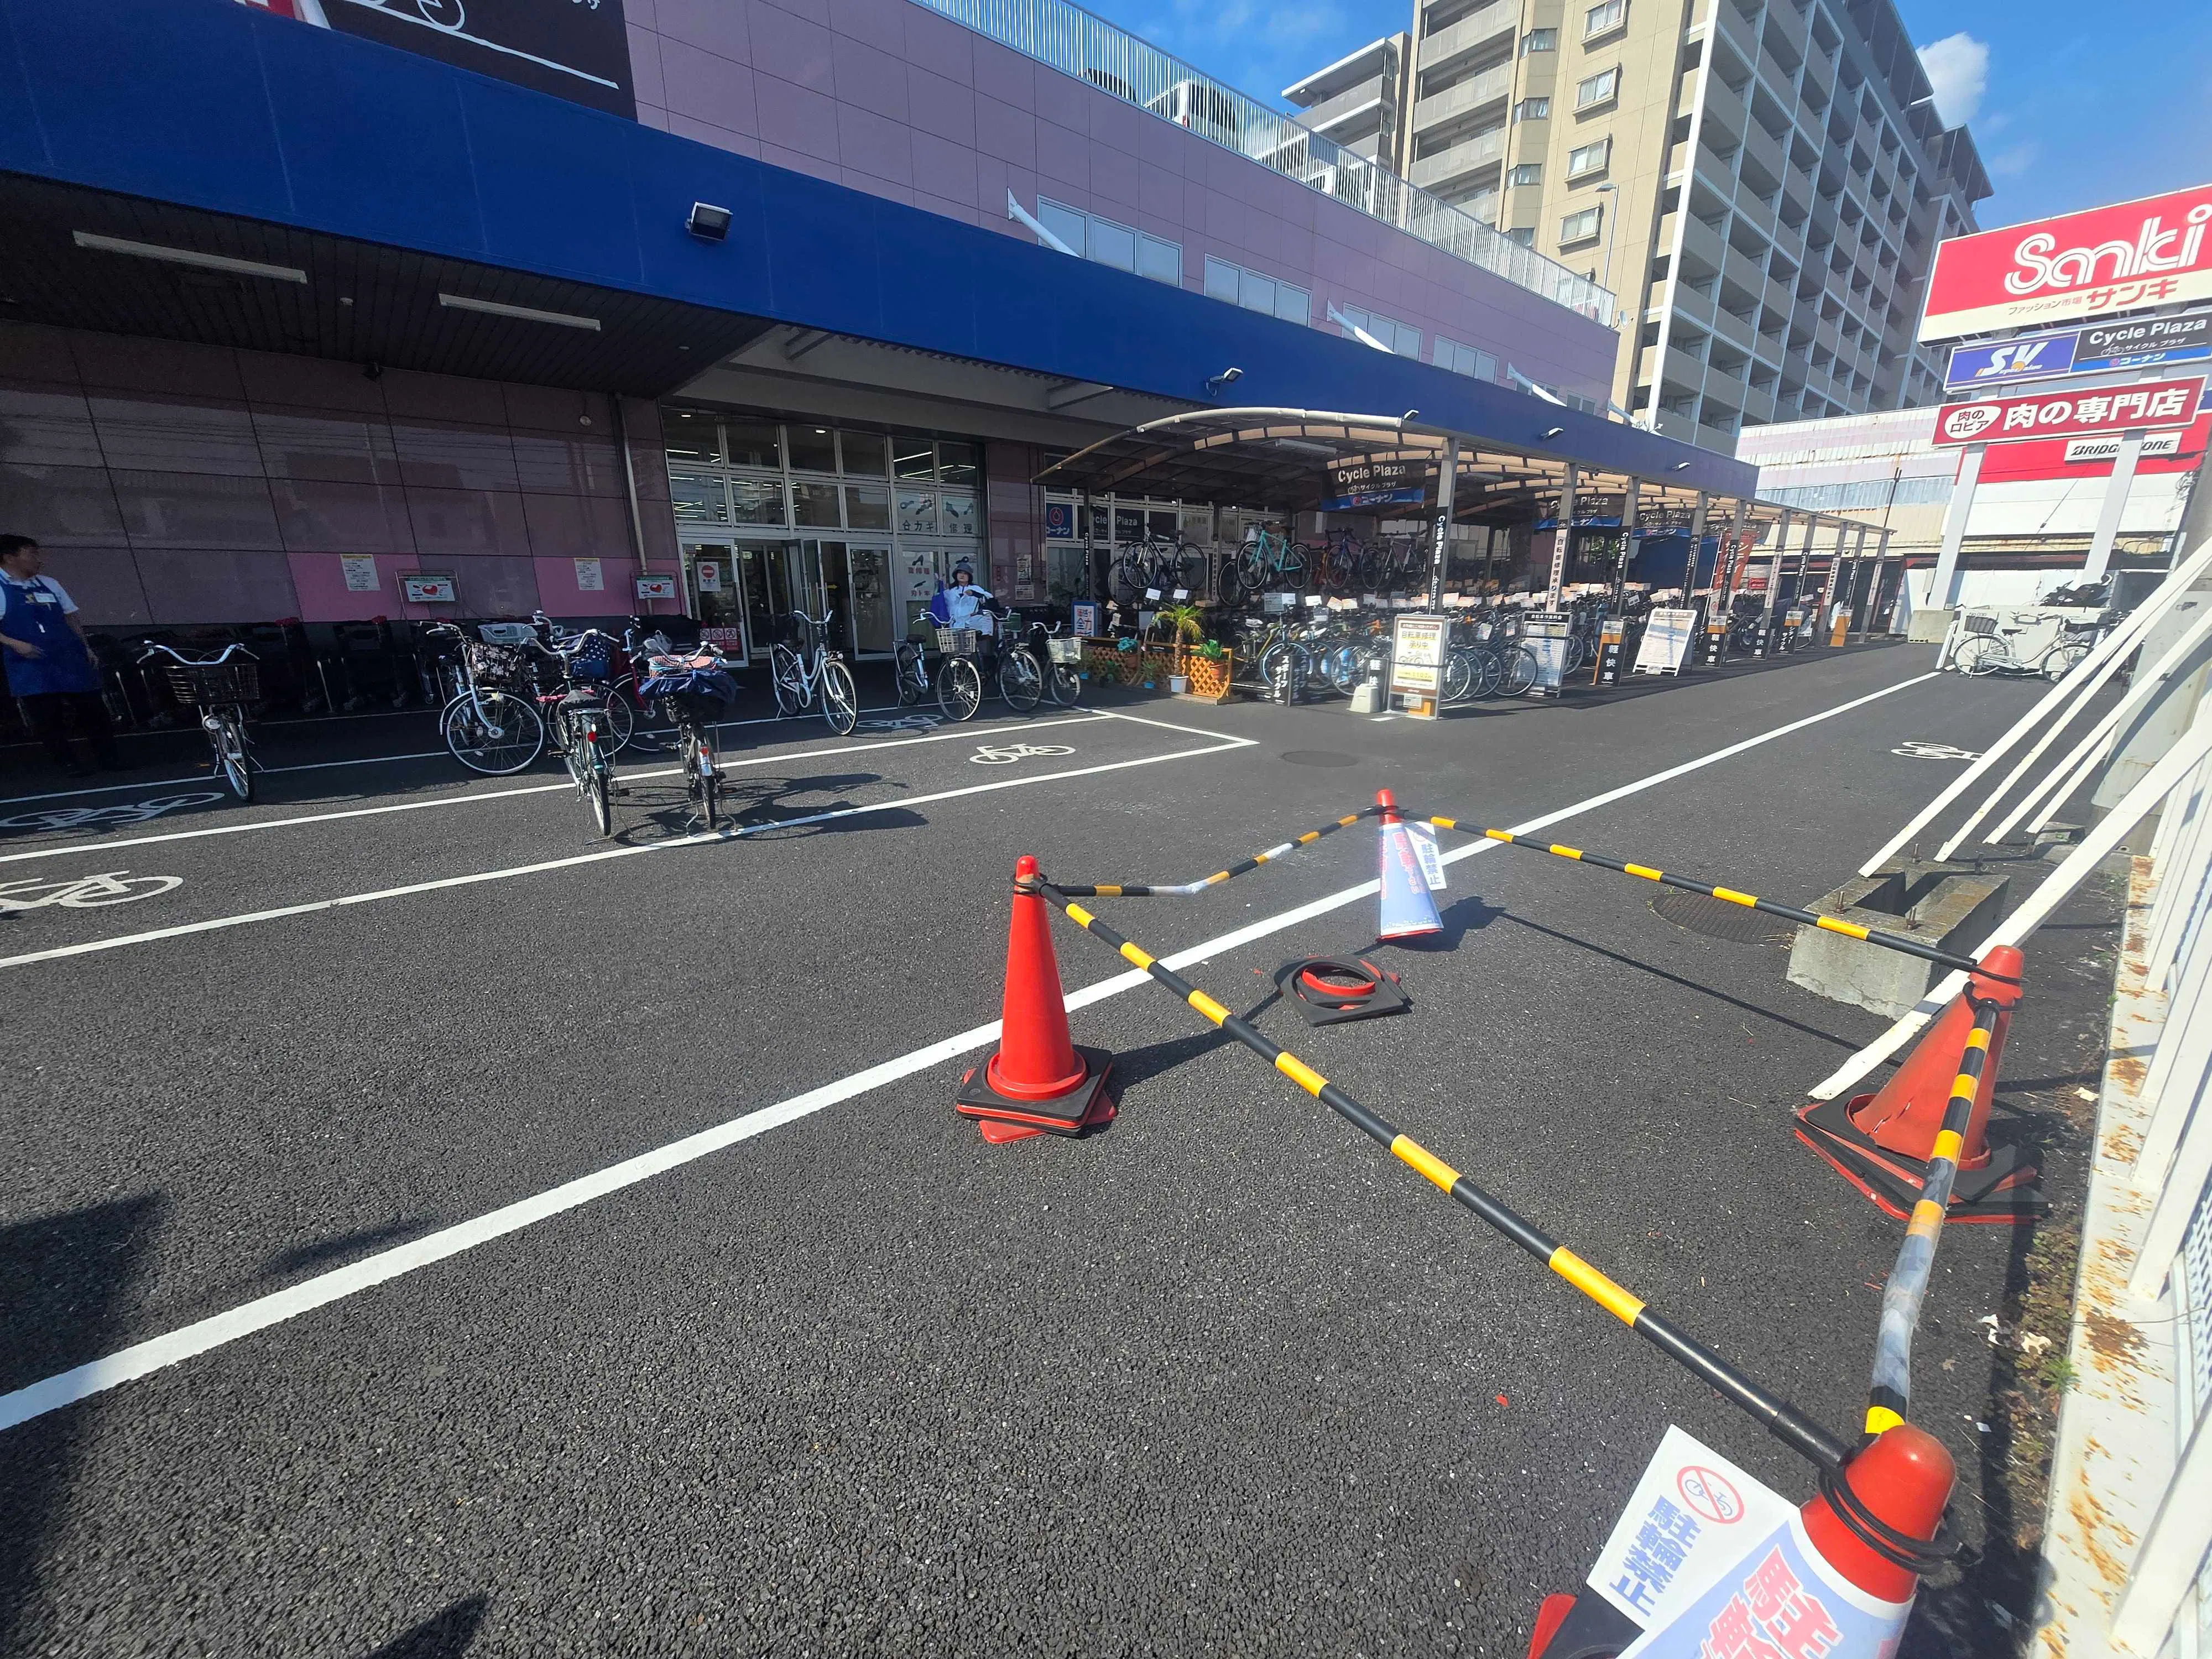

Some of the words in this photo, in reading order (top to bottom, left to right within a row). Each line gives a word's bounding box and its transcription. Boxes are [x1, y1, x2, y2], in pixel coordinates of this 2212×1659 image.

[2004, 204, 2212, 295] Sanki
[2008, 296, 2083, 315] ファッション市場
[2086, 278, 2181, 311] サンキ
[2089, 326, 2146, 346] Cycle
[2150, 319, 2208, 336] Plaza
[2125, 342, 2158, 351] サイクル
[2119, 352, 2166, 366] コーナン
[1958, 410, 1984, 422] 肉の
[2002, 387, 2190, 431] 肉の専門店
[1950, 419, 1990, 434] ロピア
[2070, 440, 2174, 456] BRIDGONE
[1338, 467, 1370, 483] Cycle
[1373, 464, 1406, 477] Plaza
[1361, 493, 1393, 504] コーナン
[1580, 497, 1608, 505] Plaza
[1117, 515, 1138, 526] Plaza
[1639, 512, 1665, 521] Cycle
[1666, 510, 1691, 519] Plaza
[1436, 515, 1446, 540] Cycle
[1620, 532, 1629, 551] Cycle
[1433, 541, 1444, 565] Plaza
[1617, 551, 1626, 569] Plaza
[1728, 545, 1736, 559] Cycle
[1548, 539, 1564, 607] 自転車修理承ります
[1726, 560, 1734, 574] Plaza
[1706, 634, 1720, 662] 軽快車
[1603, 644, 1620, 681] 軽快車
[1608, 1494, 1703, 1618] 駐輪禁止
